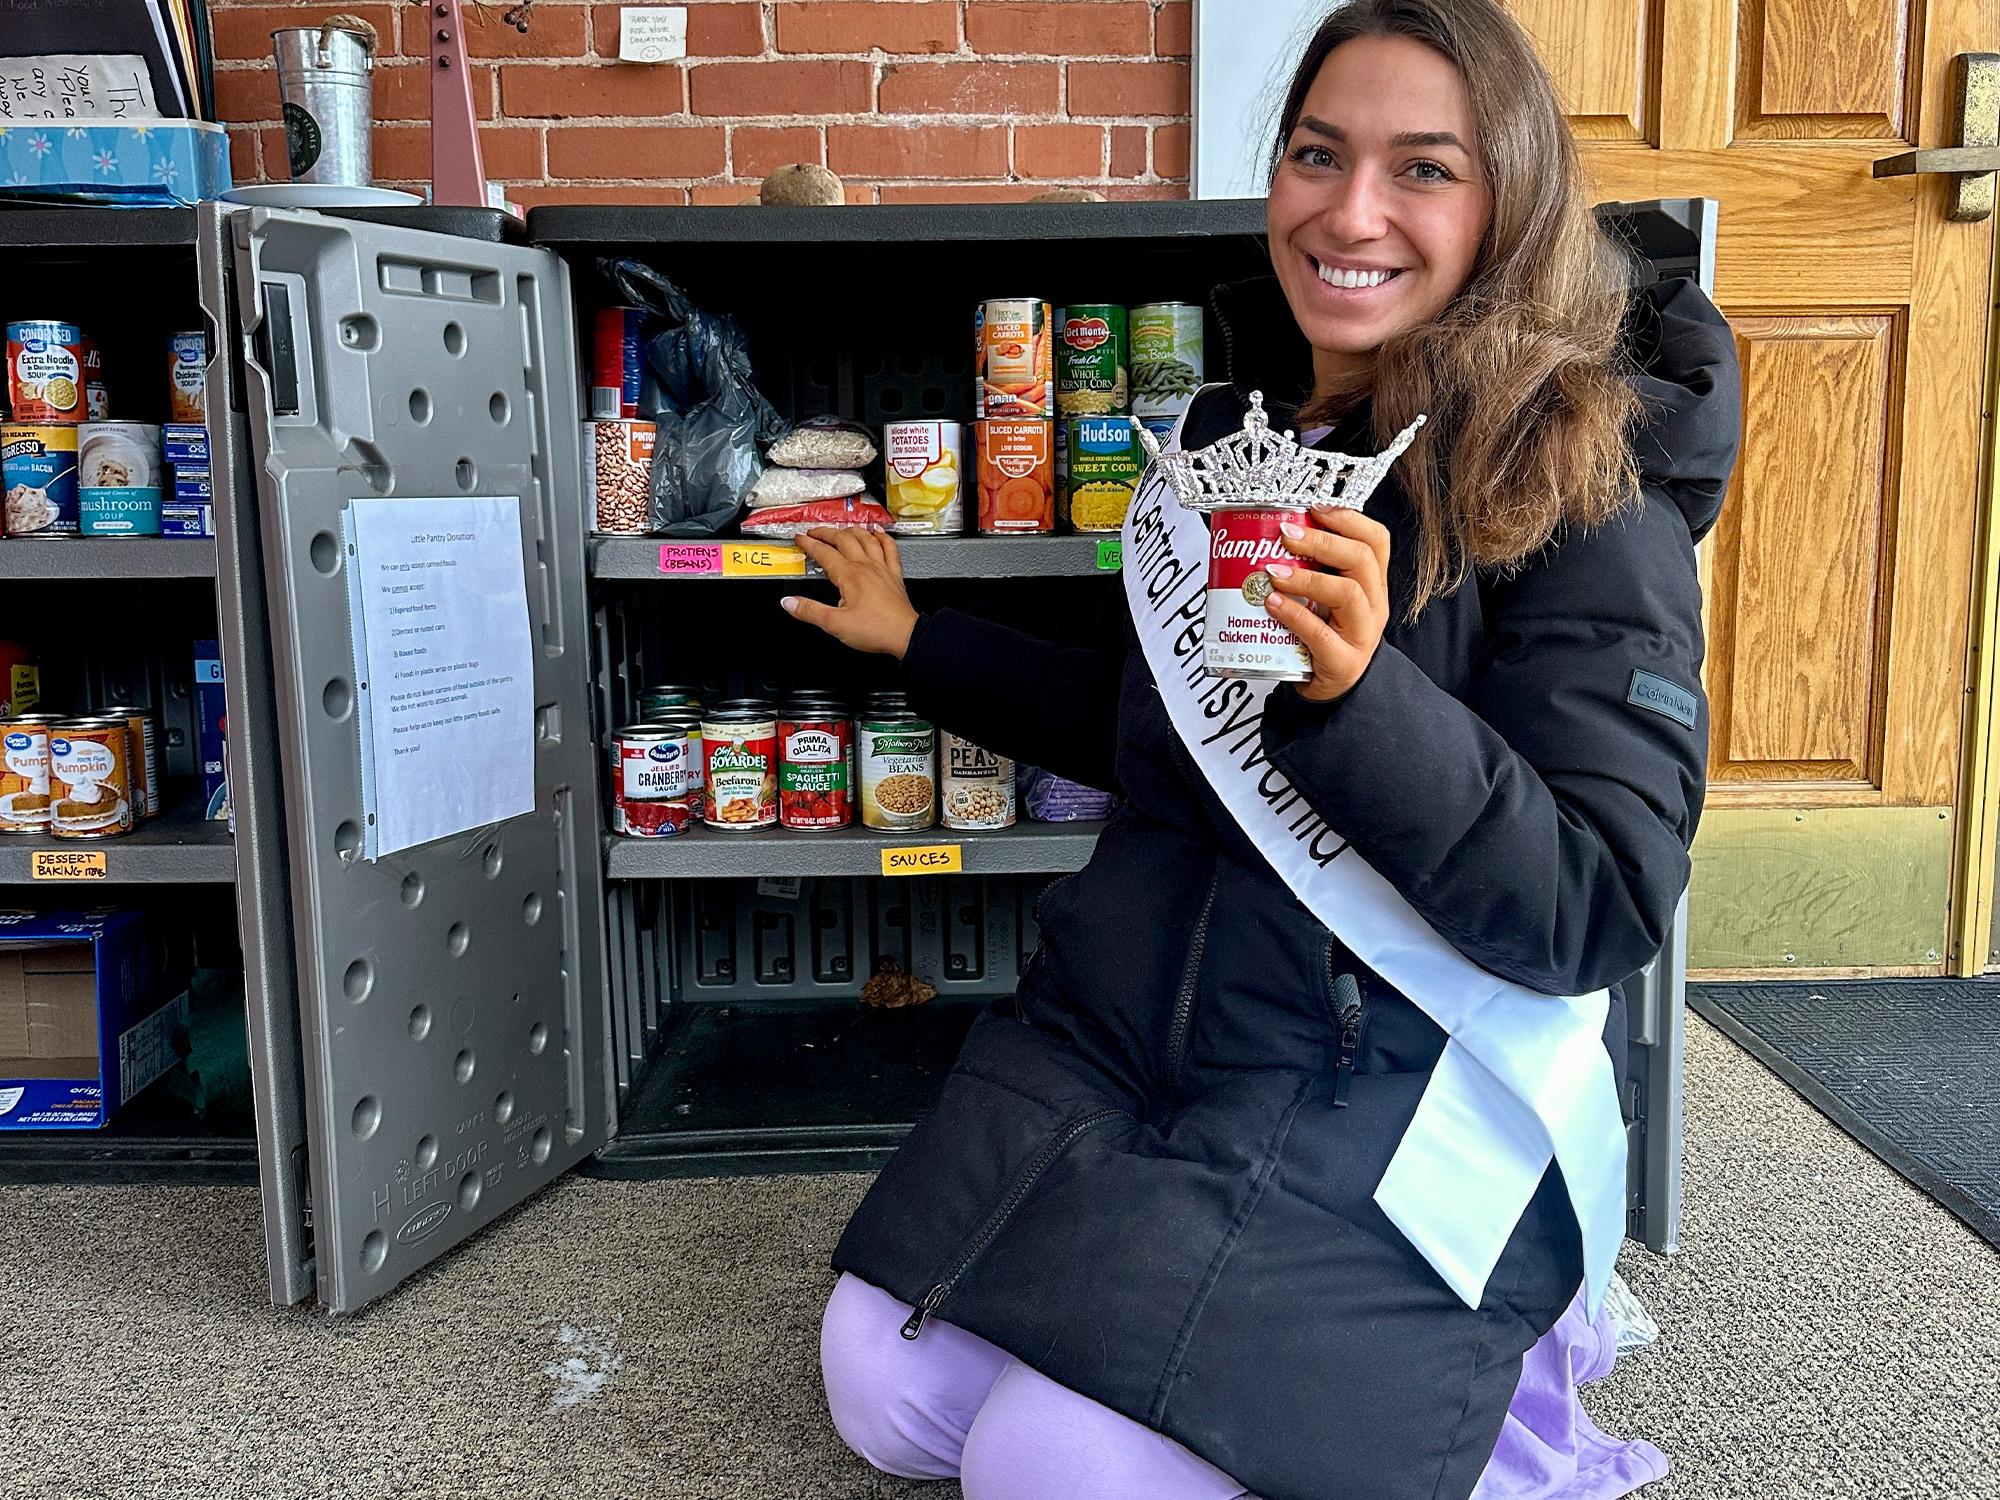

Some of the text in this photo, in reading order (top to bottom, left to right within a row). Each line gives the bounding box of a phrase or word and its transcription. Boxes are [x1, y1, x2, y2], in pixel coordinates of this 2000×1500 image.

[31, 67, 47, 98] any
[20, 328, 72, 343] CONDENSED
[1067, 328, 1105, 337] Del Monte
[22, 355, 45, 364] Extra
[47, 354, 74, 365] Noodle
[1068, 355, 1086, 365] Fresh
[1071, 369, 1100, 379] WHOLE
[1061, 379, 1112, 389] KERNEL CORN
[990, 426, 1043, 434] SLICED CARROTS
[1081, 422, 1130, 442] Hudson
[632, 432, 652, 441] PINTO
[892, 436, 929, 445] POTATOES
[31, 464, 54, 473] BACON
[1073, 464, 1138, 472] SWEET CORN
[81, 497, 152, 511] mushroom
[411, 532, 475, 543] Little Pantry Donations
[1132, 476, 1201, 613] Central
[667, 547, 719, 558] PROTIENS
[665, 559, 712, 570] (BEANS)
[732, 552, 772, 566] RICE
[400, 562, 410, 571] only
[382, 585, 391, 593] We
[1219, 632, 1299, 645] Chicken Noodle
[1238, 654, 1272, 664] SOUP
[797, 736, 827, 746] PRIMA
[394, 747, 409, 756] Thank
[650, 750, 667, 759] Ocean
[714, 747, 732, 757] Chef
[793, 745, 831, 756] QUALITA
[13, 757, 47, 768] Pump
[710, 755, 768, 770] BOYARDEE
[883, 756, 928, 765] Vegetarian
[951, 748, 998, 767] PEAS
[56, 762, 107, 773] Pumpkin
[651, 764, 680, 772] JELLIED
[889, 763, 924, 773] BEANS
[716, 776, 760, 787] Beefaroni
[787, 773, 839, 783] SPAGHETTI
[795, 783, 830, 791] SAUCE
[39, 854, 96, 865] DESSERT
[890, 853, 950, 867] SAUCES
[37, 865, 82, 876] BAKING
[403, 1168, 440, 1207] LEFT
[373, 1183, 391, 1223] H
